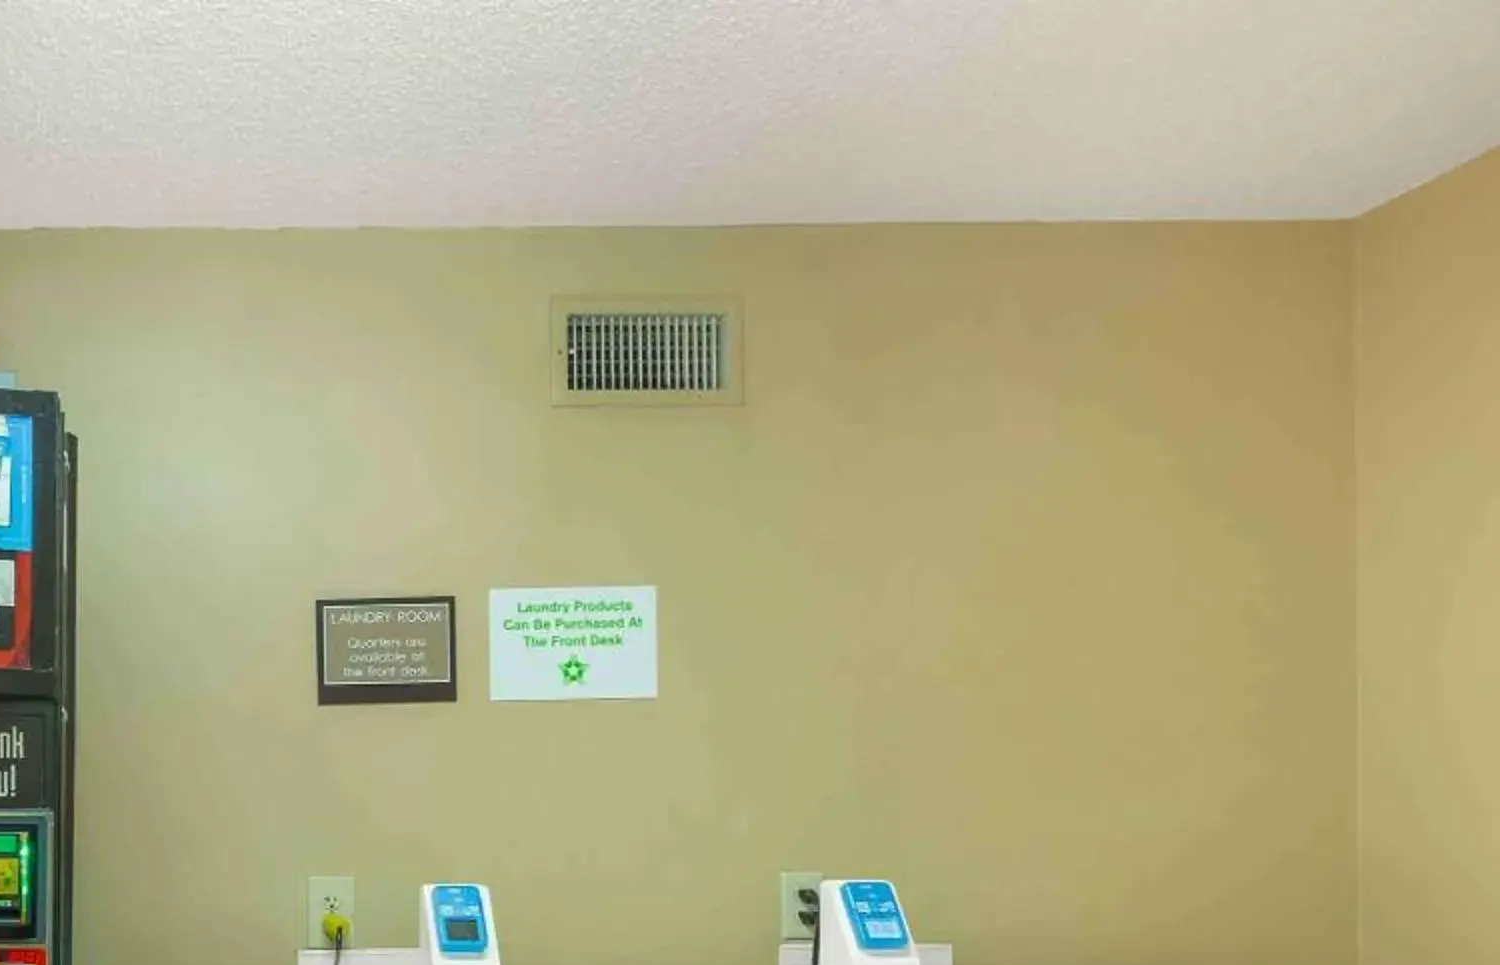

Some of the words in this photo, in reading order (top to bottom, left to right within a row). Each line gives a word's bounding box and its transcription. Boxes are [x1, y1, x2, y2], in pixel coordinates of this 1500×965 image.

[517, 601, 571, 614] Laundry
[574, 600, 634, 613] Products
[331, 609, 391, 625] LAUNDRY
[398, 609, 442, 623] ROOM
[503, 619, 530, 631] Can
[533, 618, 551, 630] Be
[555, 616, 625, 629] Purchased
[629, 615, 643, 627] At
[347, 637, 402, 649] Quarters
[524, 635, 548, 648] The
[551, 634, 587, 647] Front
[590, 633, 623, 646] Desk
